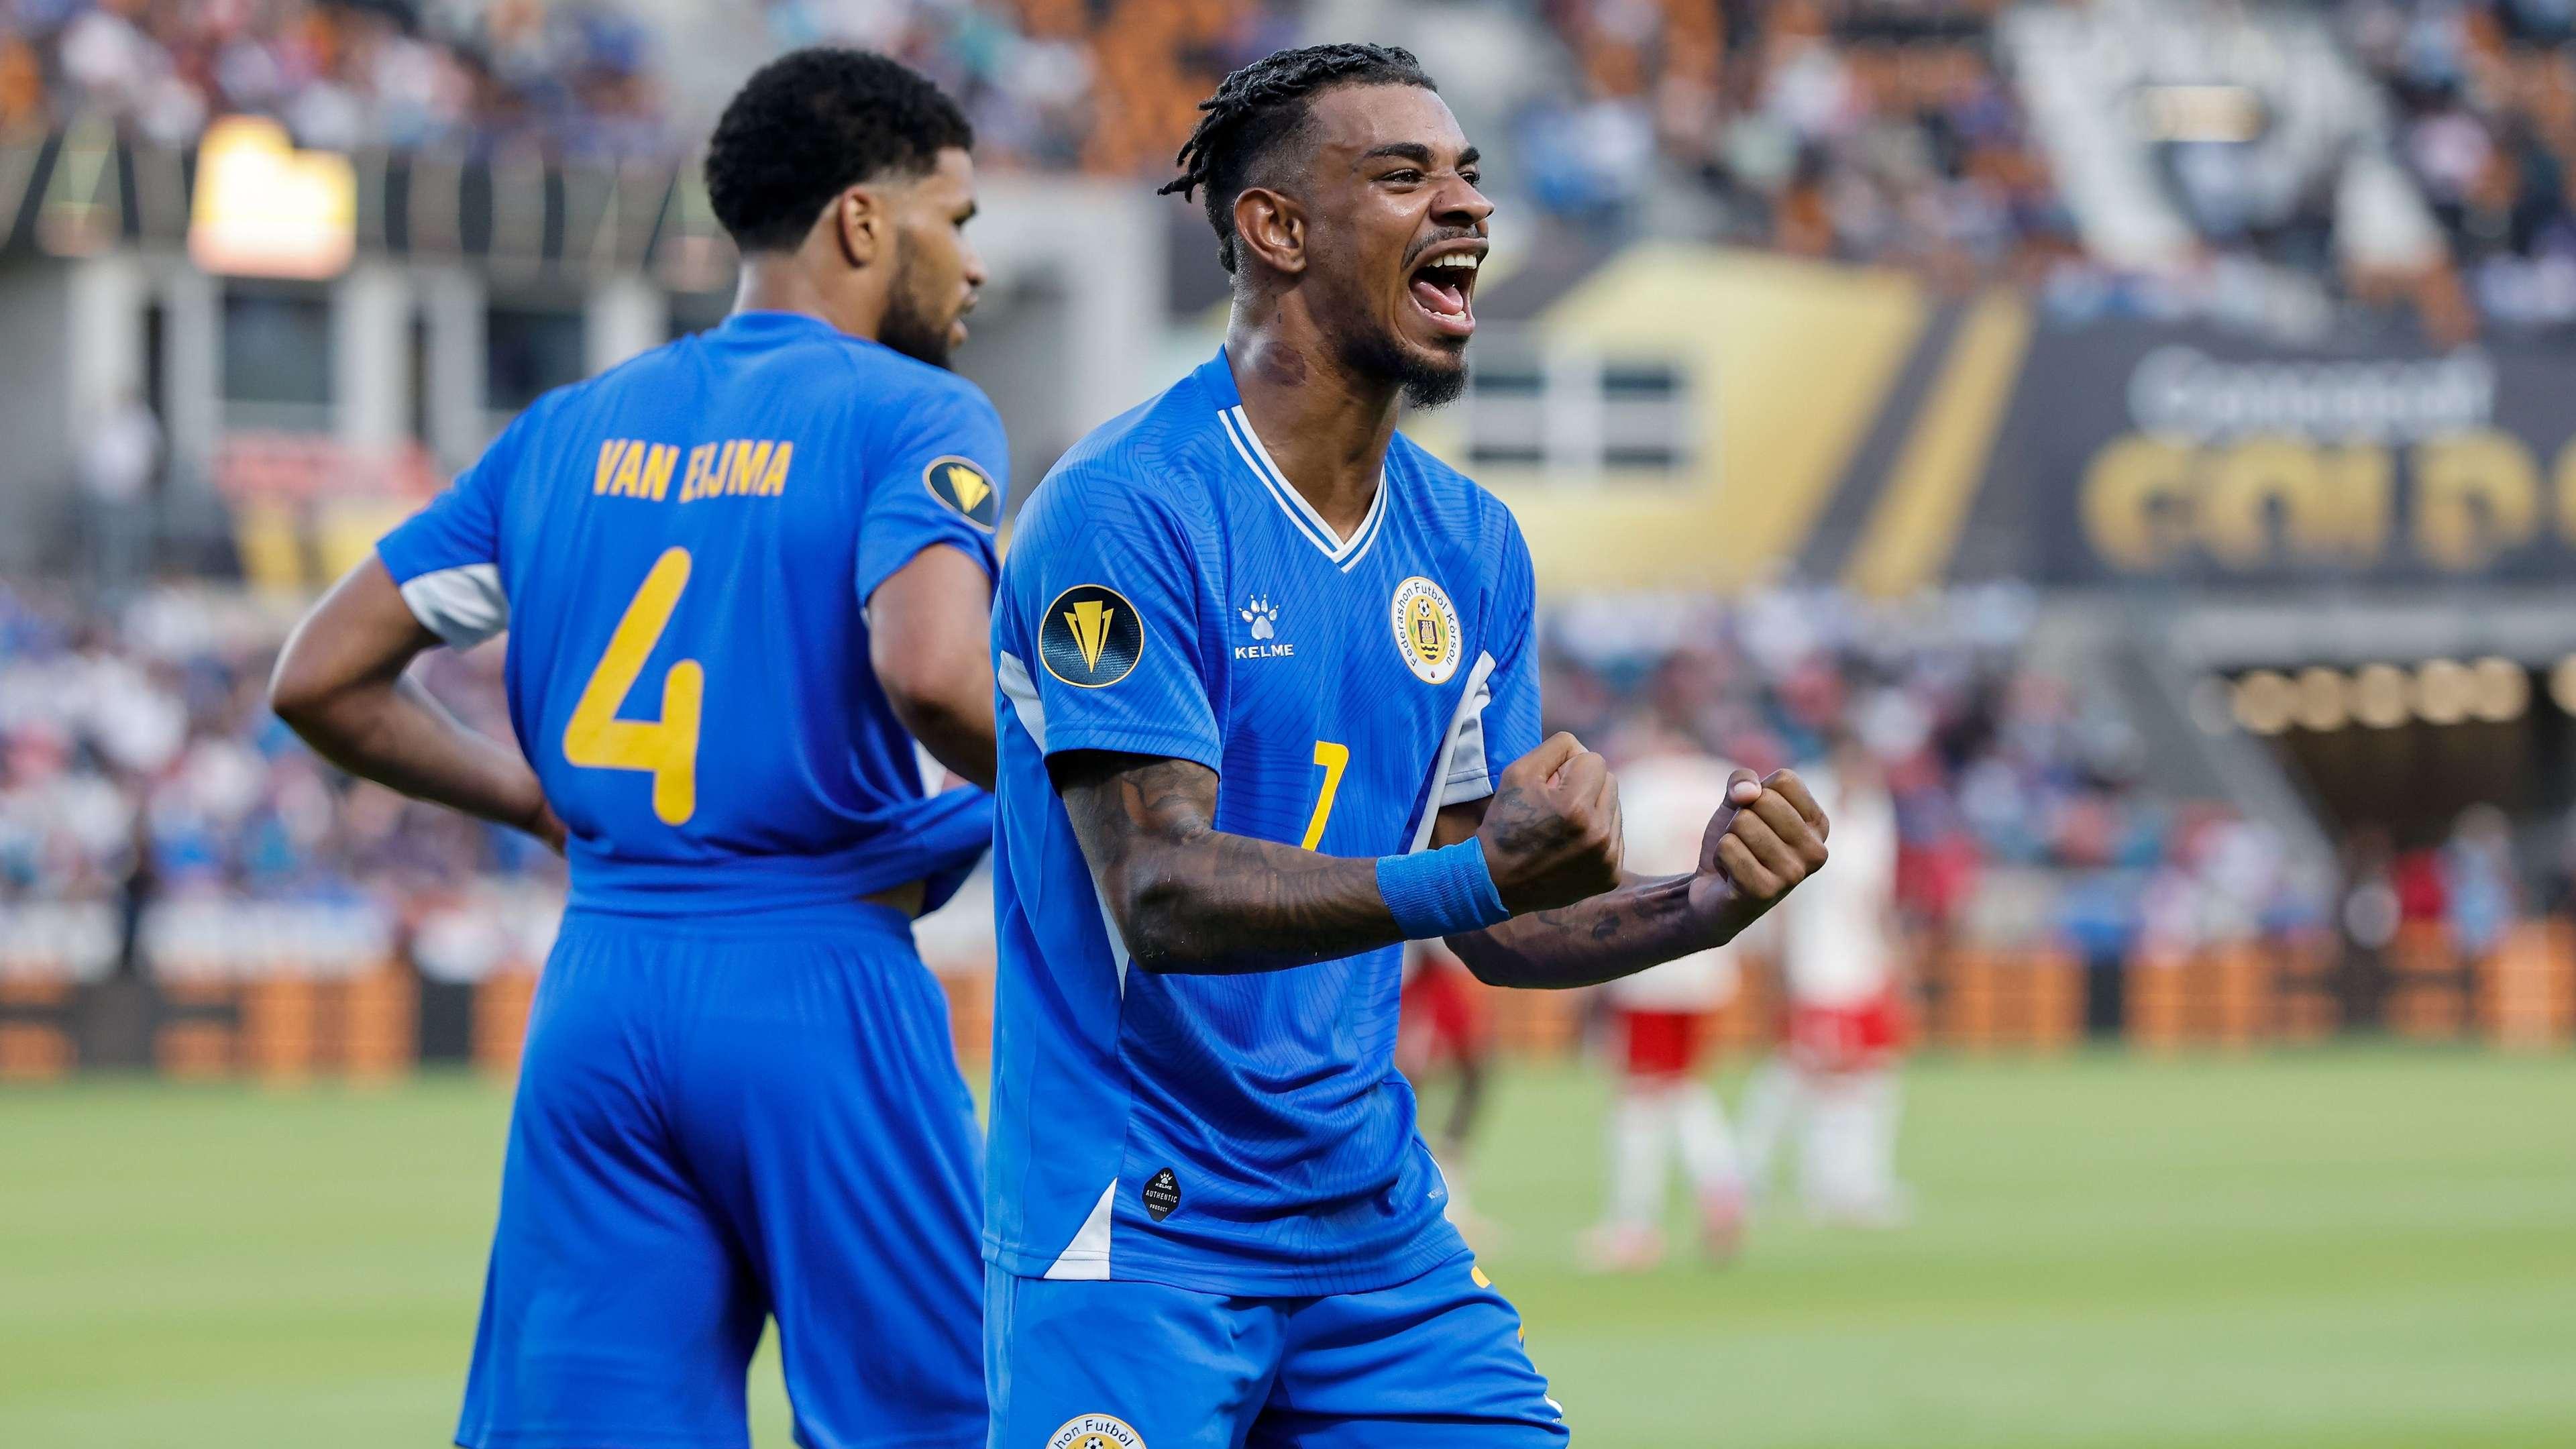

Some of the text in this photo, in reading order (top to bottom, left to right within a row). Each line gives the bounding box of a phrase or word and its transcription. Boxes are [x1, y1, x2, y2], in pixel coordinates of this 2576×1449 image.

[593, 438, 794, 504] VAN EIJMA
[1235, 645, 1294, 659] KELME
[1397, 588, 1417, 666] Federashon
[563, 546, 704, 825] 4
[1301, 740, 1349, 852] 7
[1146, 1189, 1177, 1203] AUTHENTIC
